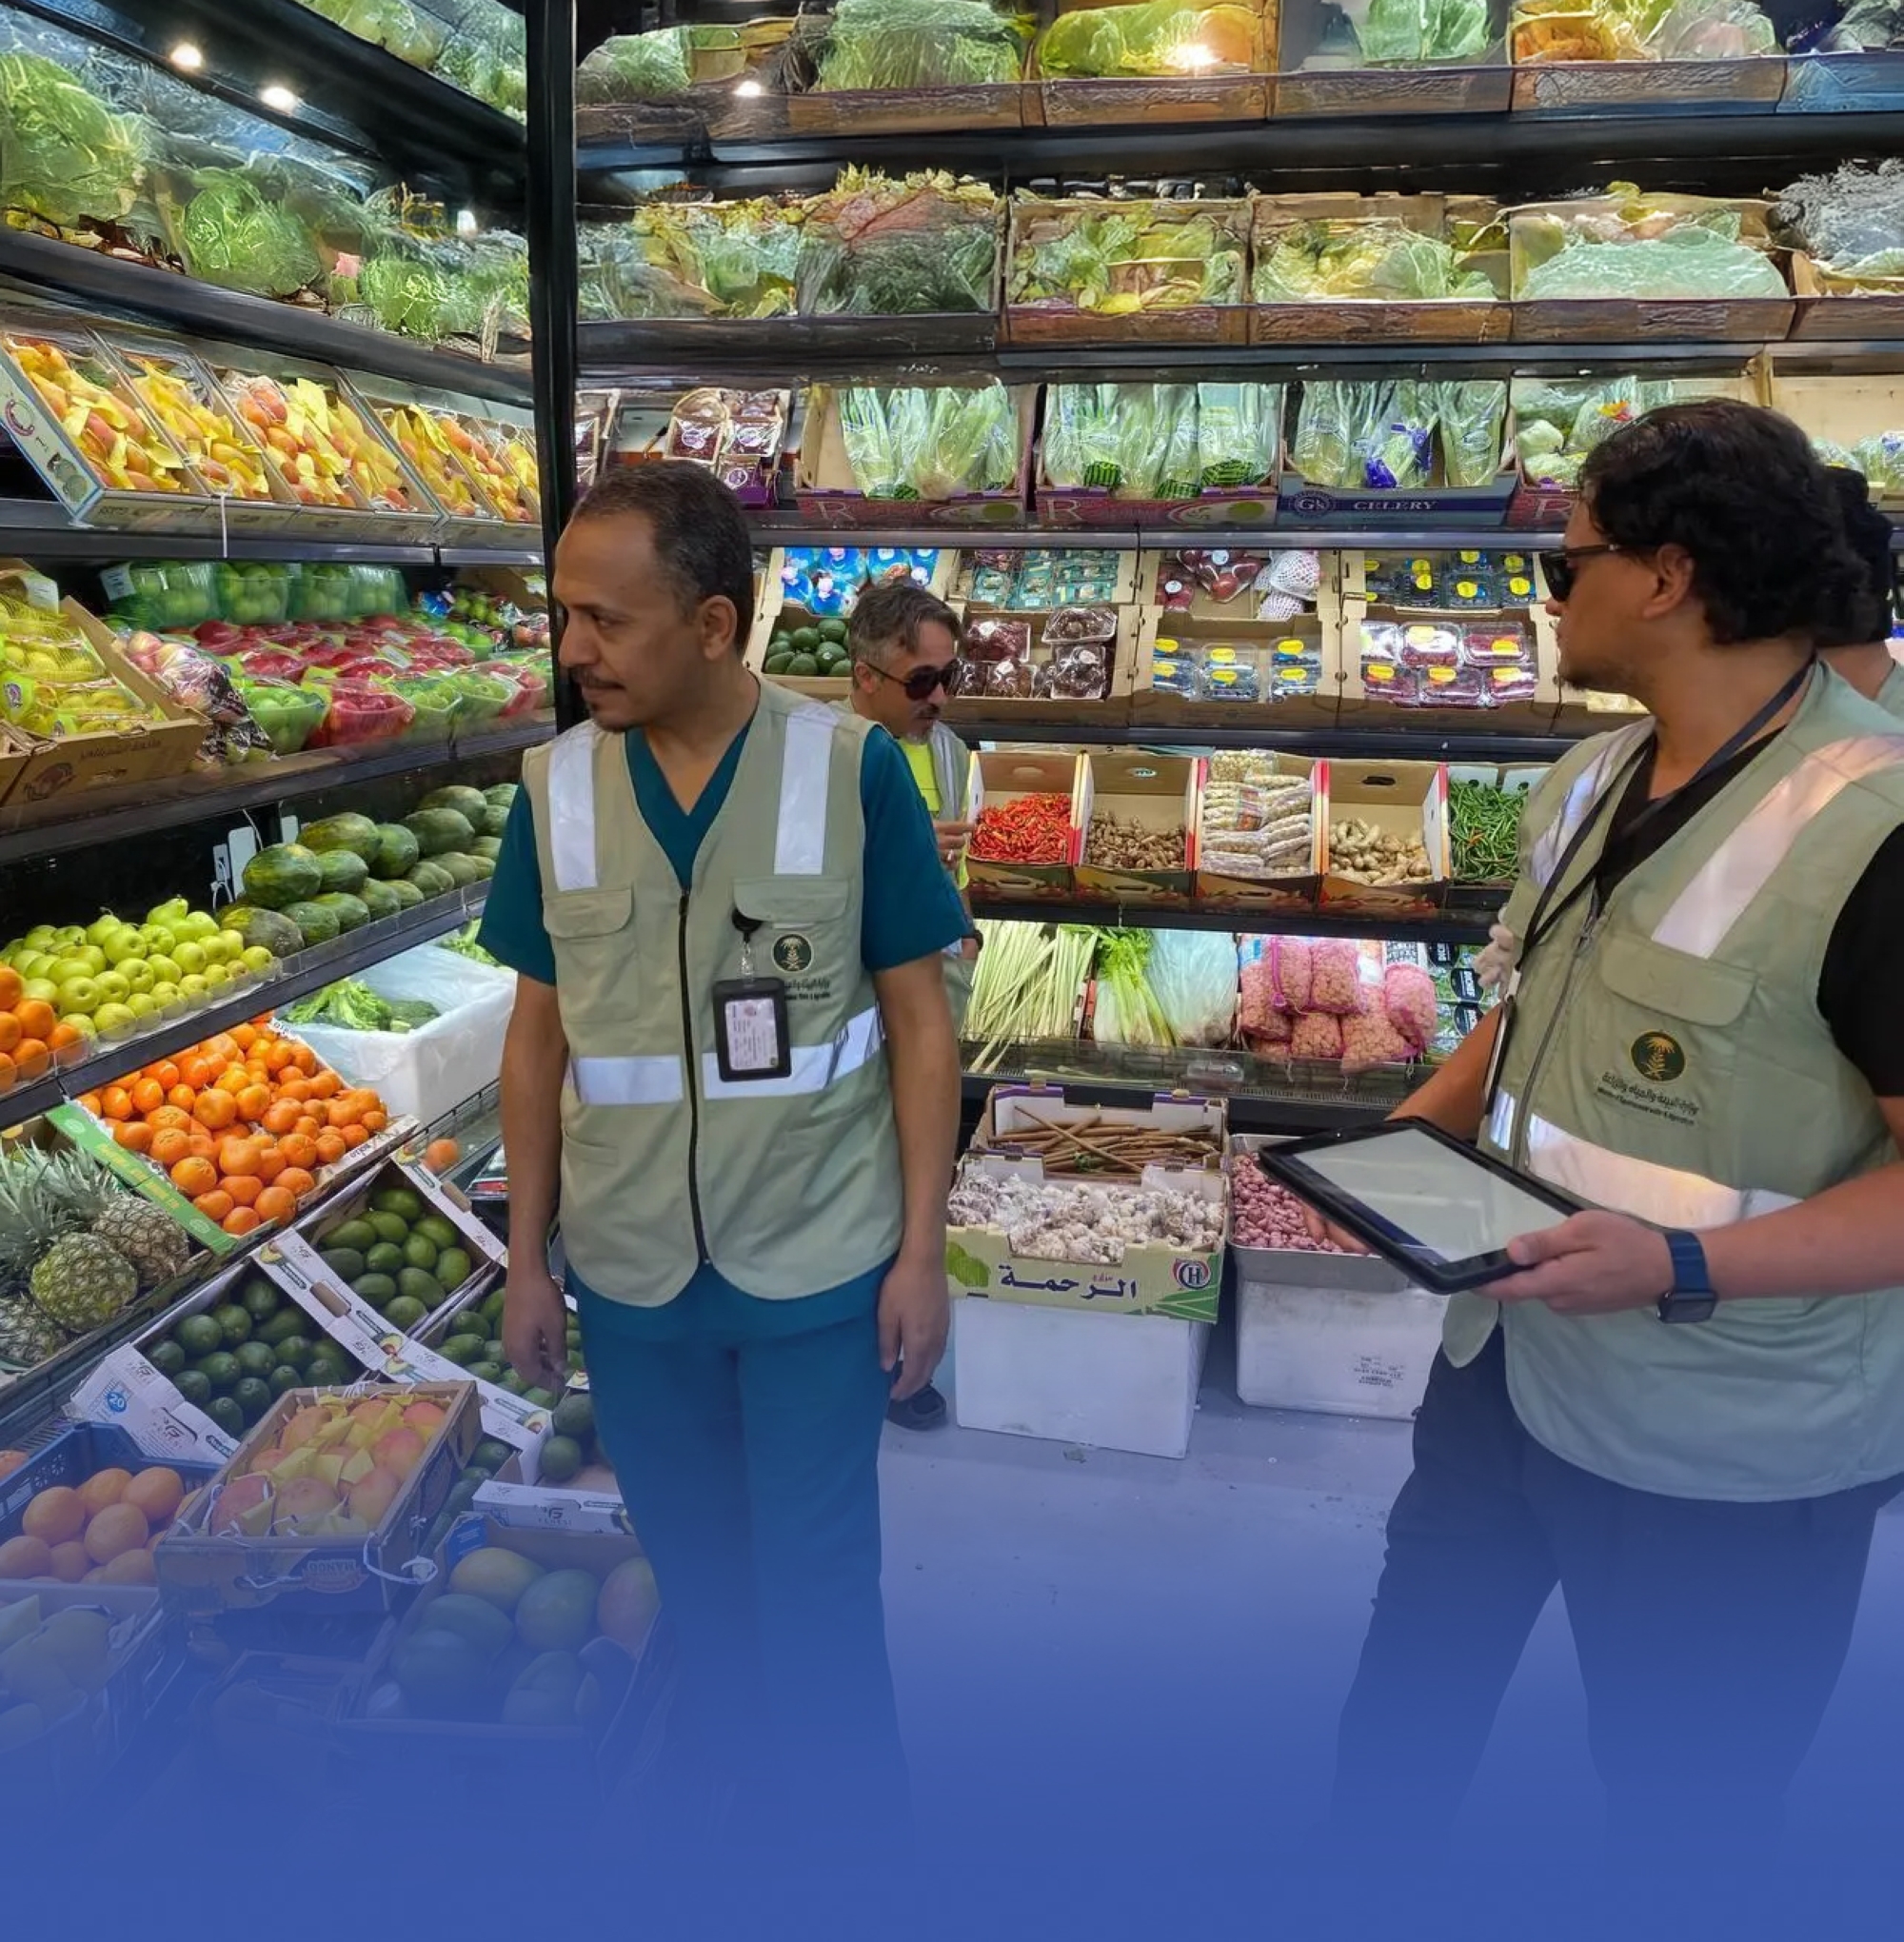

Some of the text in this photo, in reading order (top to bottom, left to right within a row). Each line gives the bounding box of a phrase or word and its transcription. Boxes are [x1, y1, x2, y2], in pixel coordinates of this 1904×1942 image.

[1353, 500, 1438, 511] CELERY
[998, 1264, 1137, 1300] الرحمة
[109, 1393, 125, 1409] 20
